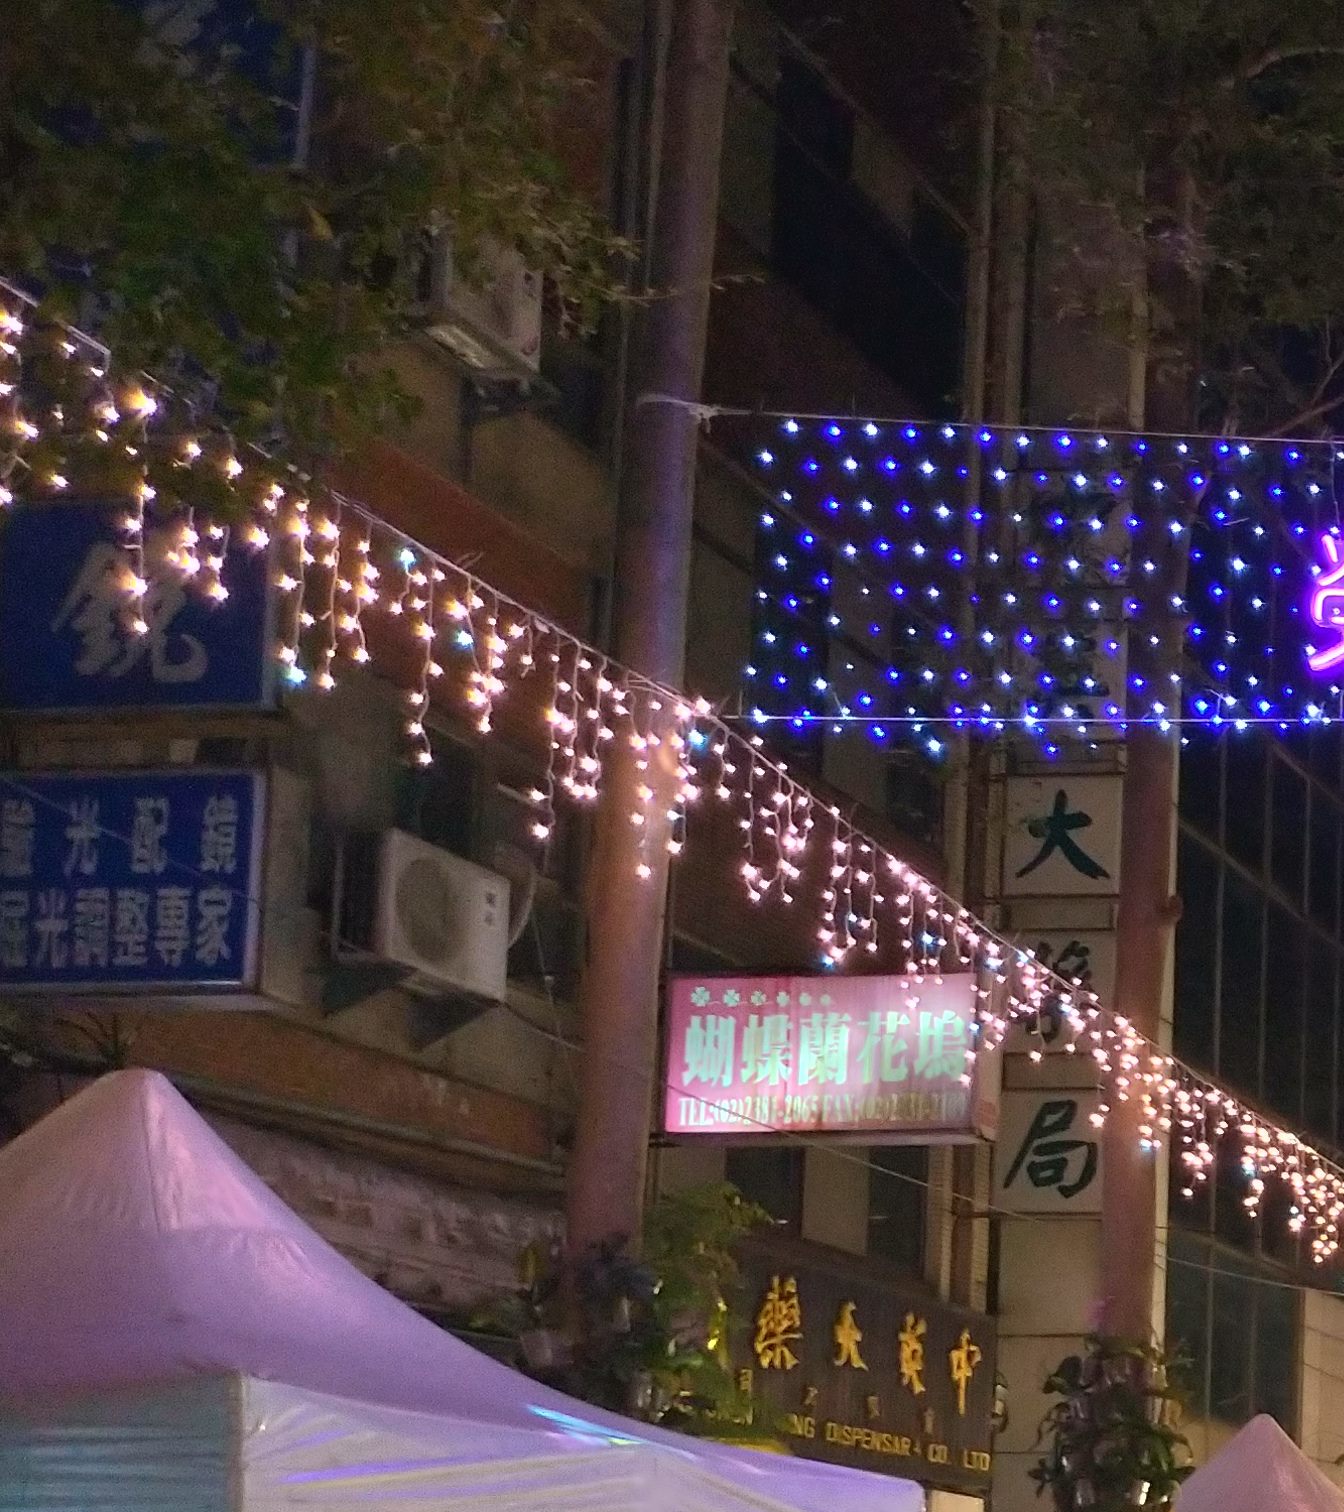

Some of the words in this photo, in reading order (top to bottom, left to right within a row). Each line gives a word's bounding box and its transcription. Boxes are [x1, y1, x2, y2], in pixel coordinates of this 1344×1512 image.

[682, 1010, 968, 1088] 蝴蝶蘭花塢
